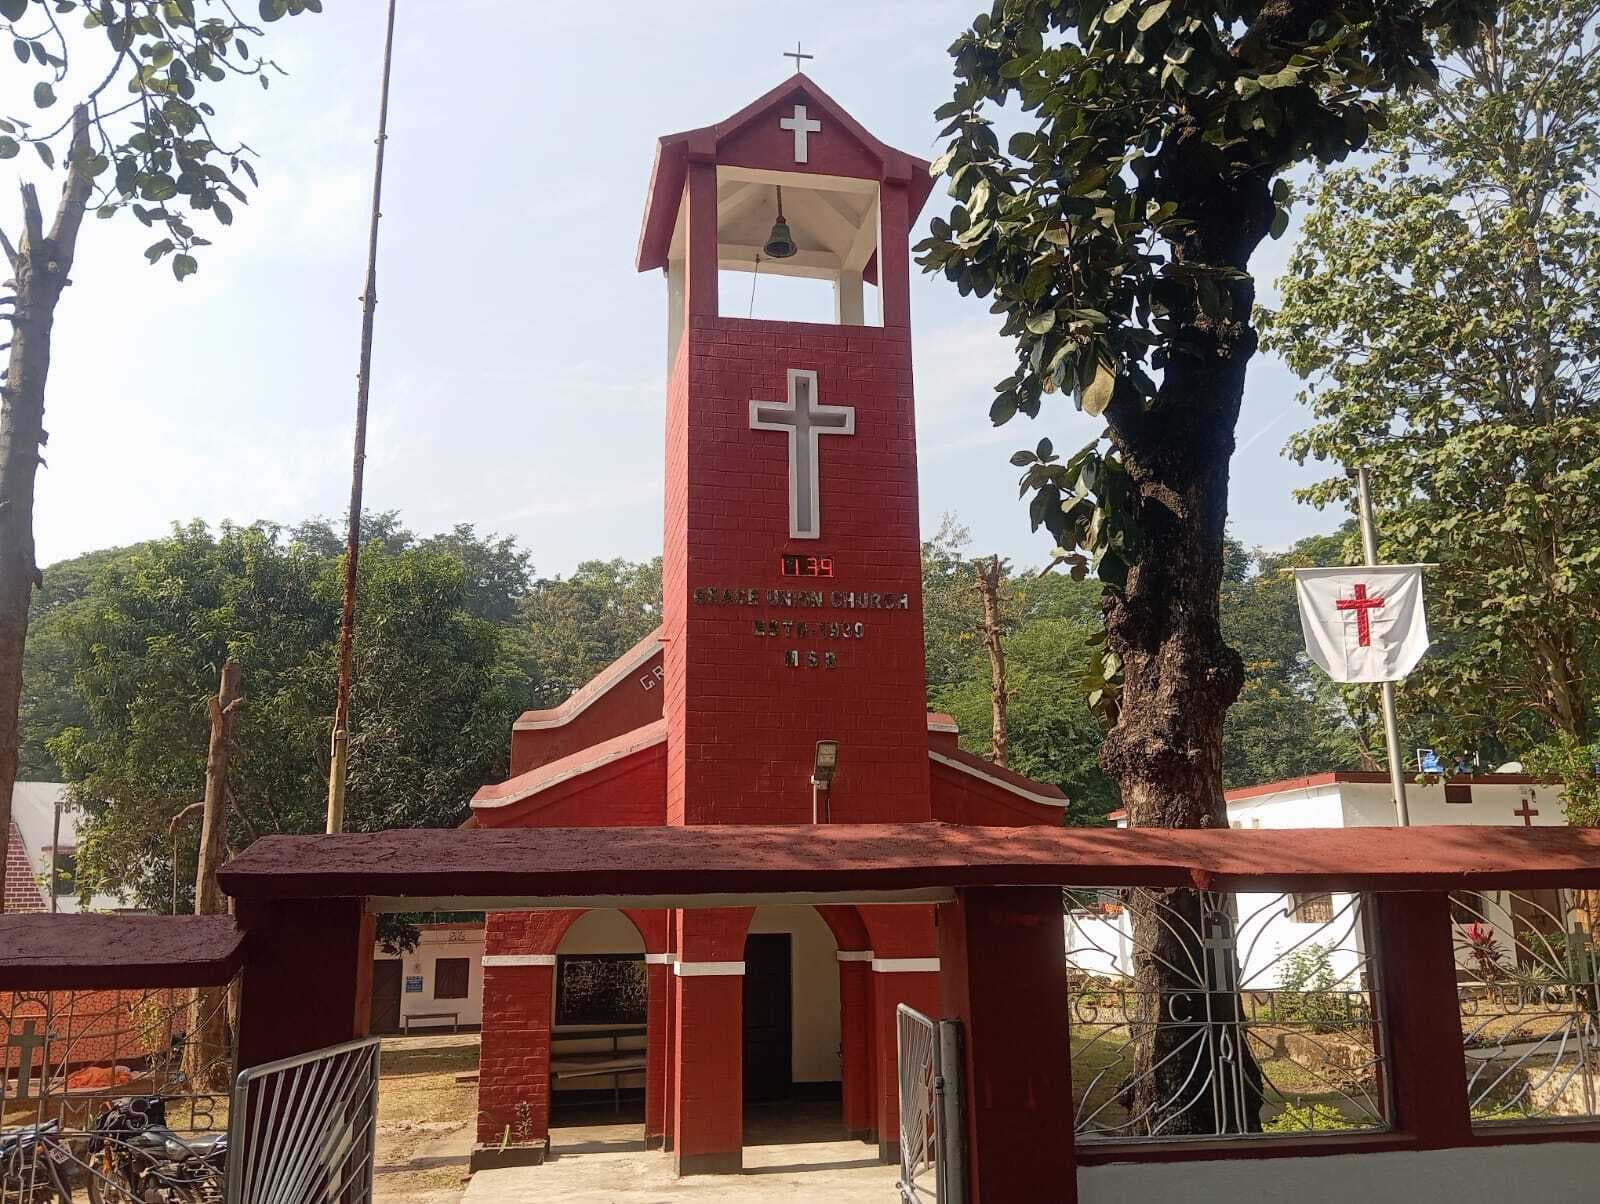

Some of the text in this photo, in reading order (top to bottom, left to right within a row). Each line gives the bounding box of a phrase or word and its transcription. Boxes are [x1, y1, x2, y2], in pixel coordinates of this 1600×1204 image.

[694, 587, 908, 609] GRACE UNION CHURCH
